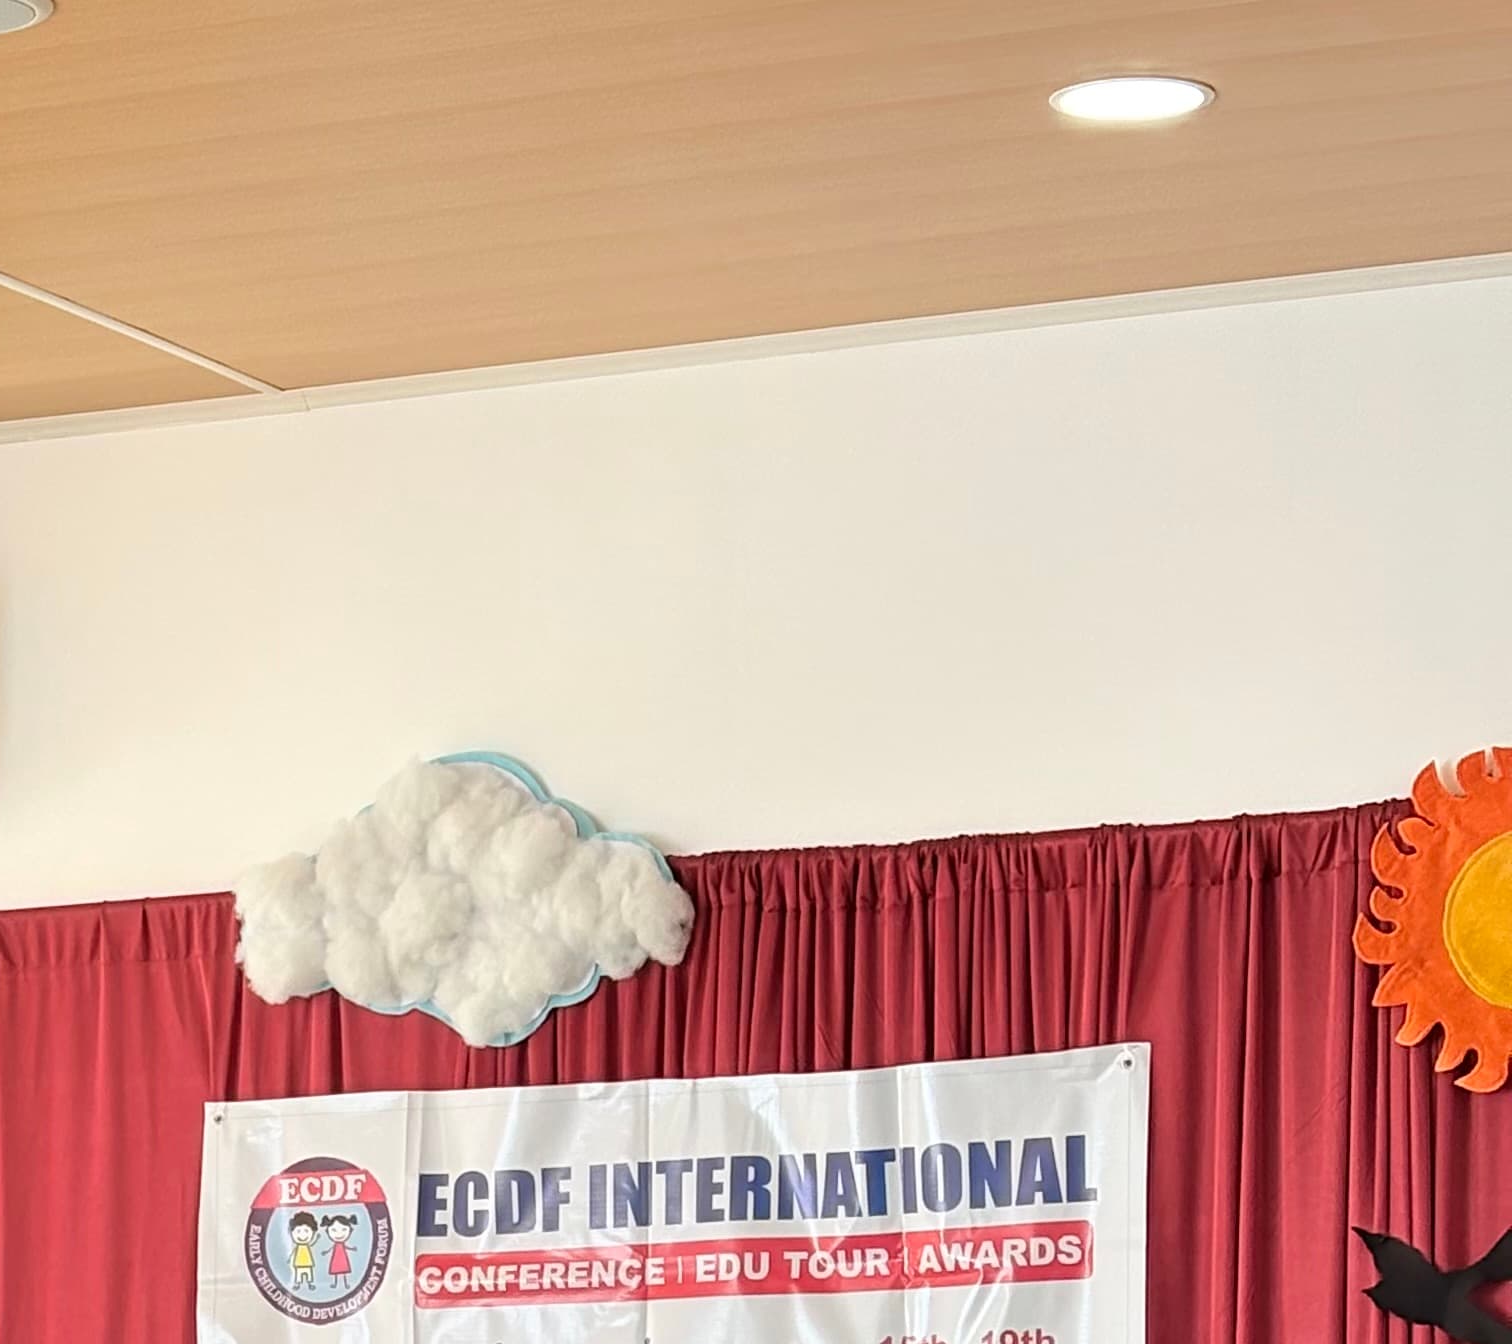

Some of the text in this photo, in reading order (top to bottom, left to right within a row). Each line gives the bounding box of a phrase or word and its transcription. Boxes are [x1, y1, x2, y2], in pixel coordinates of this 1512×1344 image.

[279, 1174, 367, 1203] ECDF
[417, 1135, 1098, 1237] ECDF INTERNATIONAL
[248, 1217, 390, 1320] EARLY CHILDHOOD DEVELOPMENT FORUM
[418, 1256, 666, 1295] CONFERENCE
[695, 1250, 771, 1284] EDU
[784, 1247, 890, 1280] TOUR
[918, 1235, 1082, 1274] AWARDS
